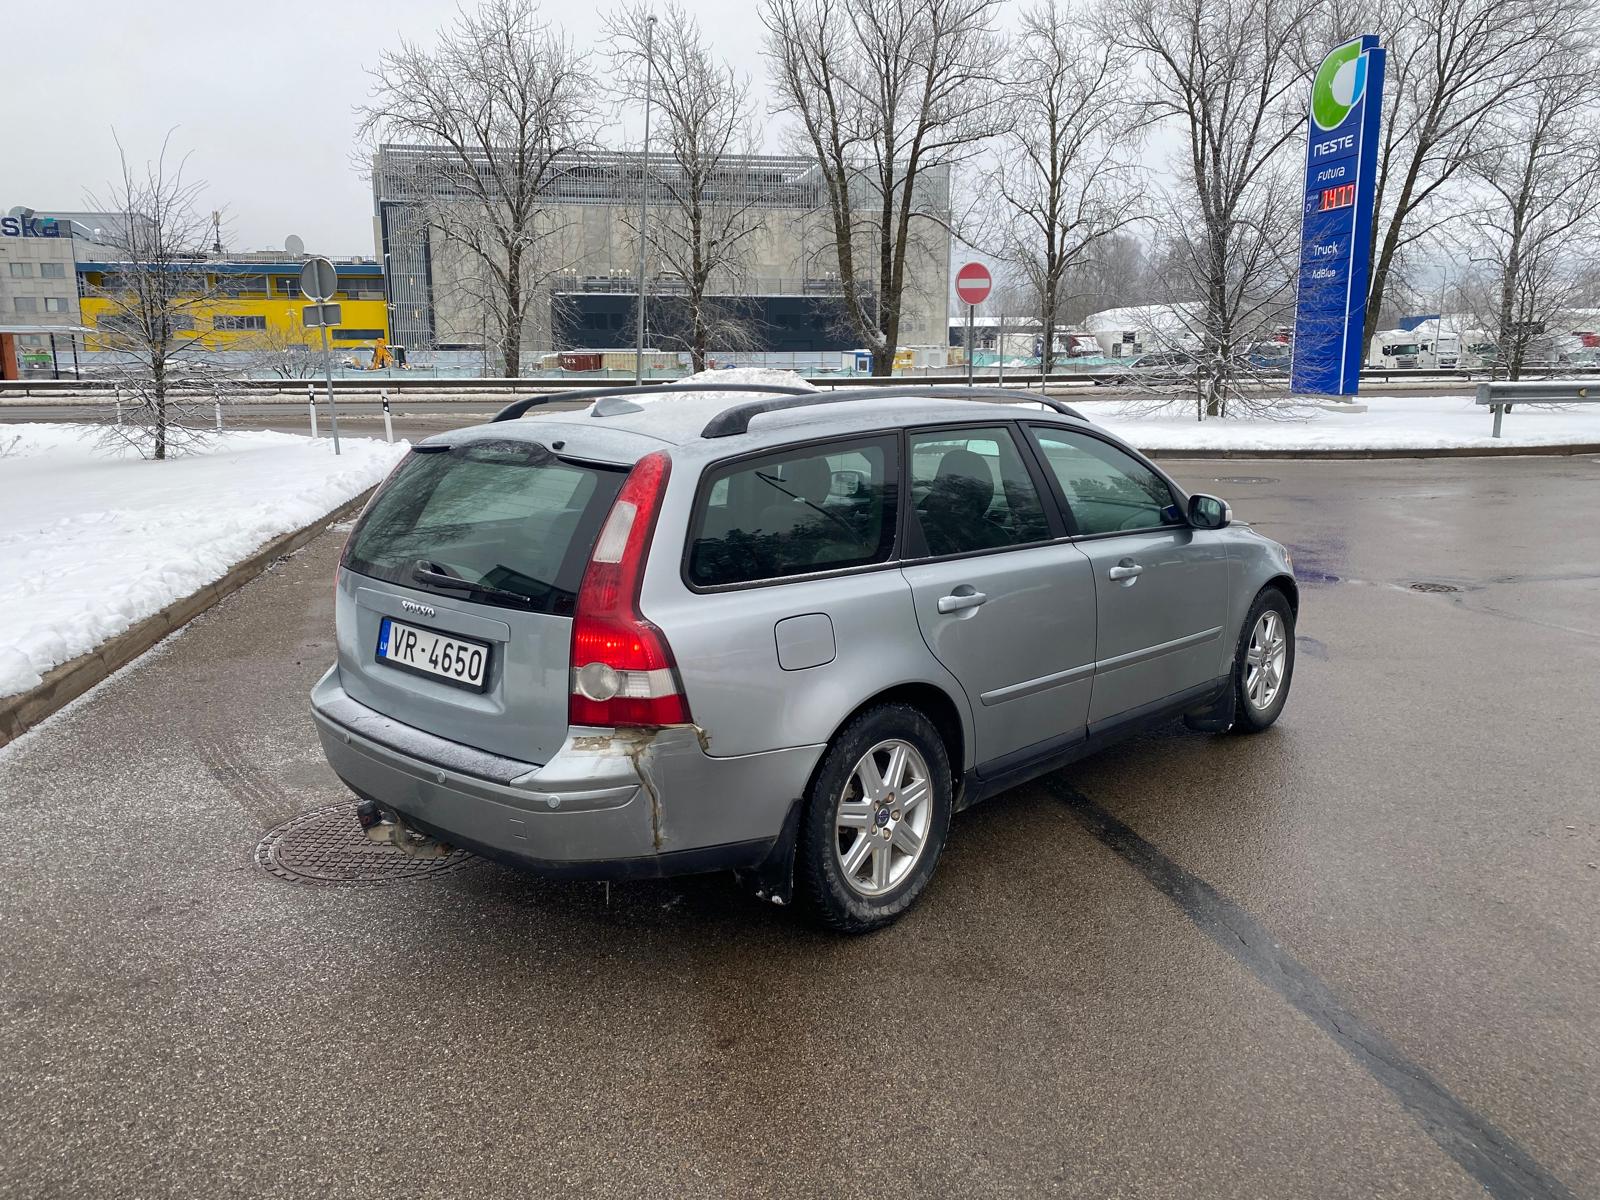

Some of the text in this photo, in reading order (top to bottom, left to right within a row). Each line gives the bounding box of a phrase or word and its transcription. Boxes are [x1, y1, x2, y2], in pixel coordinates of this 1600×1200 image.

[1314, 135, 1354, 157] NESTE
[1317, 166, 1346, 182] Futura
[1313, 241, 1338, 256] Truck
[380, 641, 388, 651] LV
